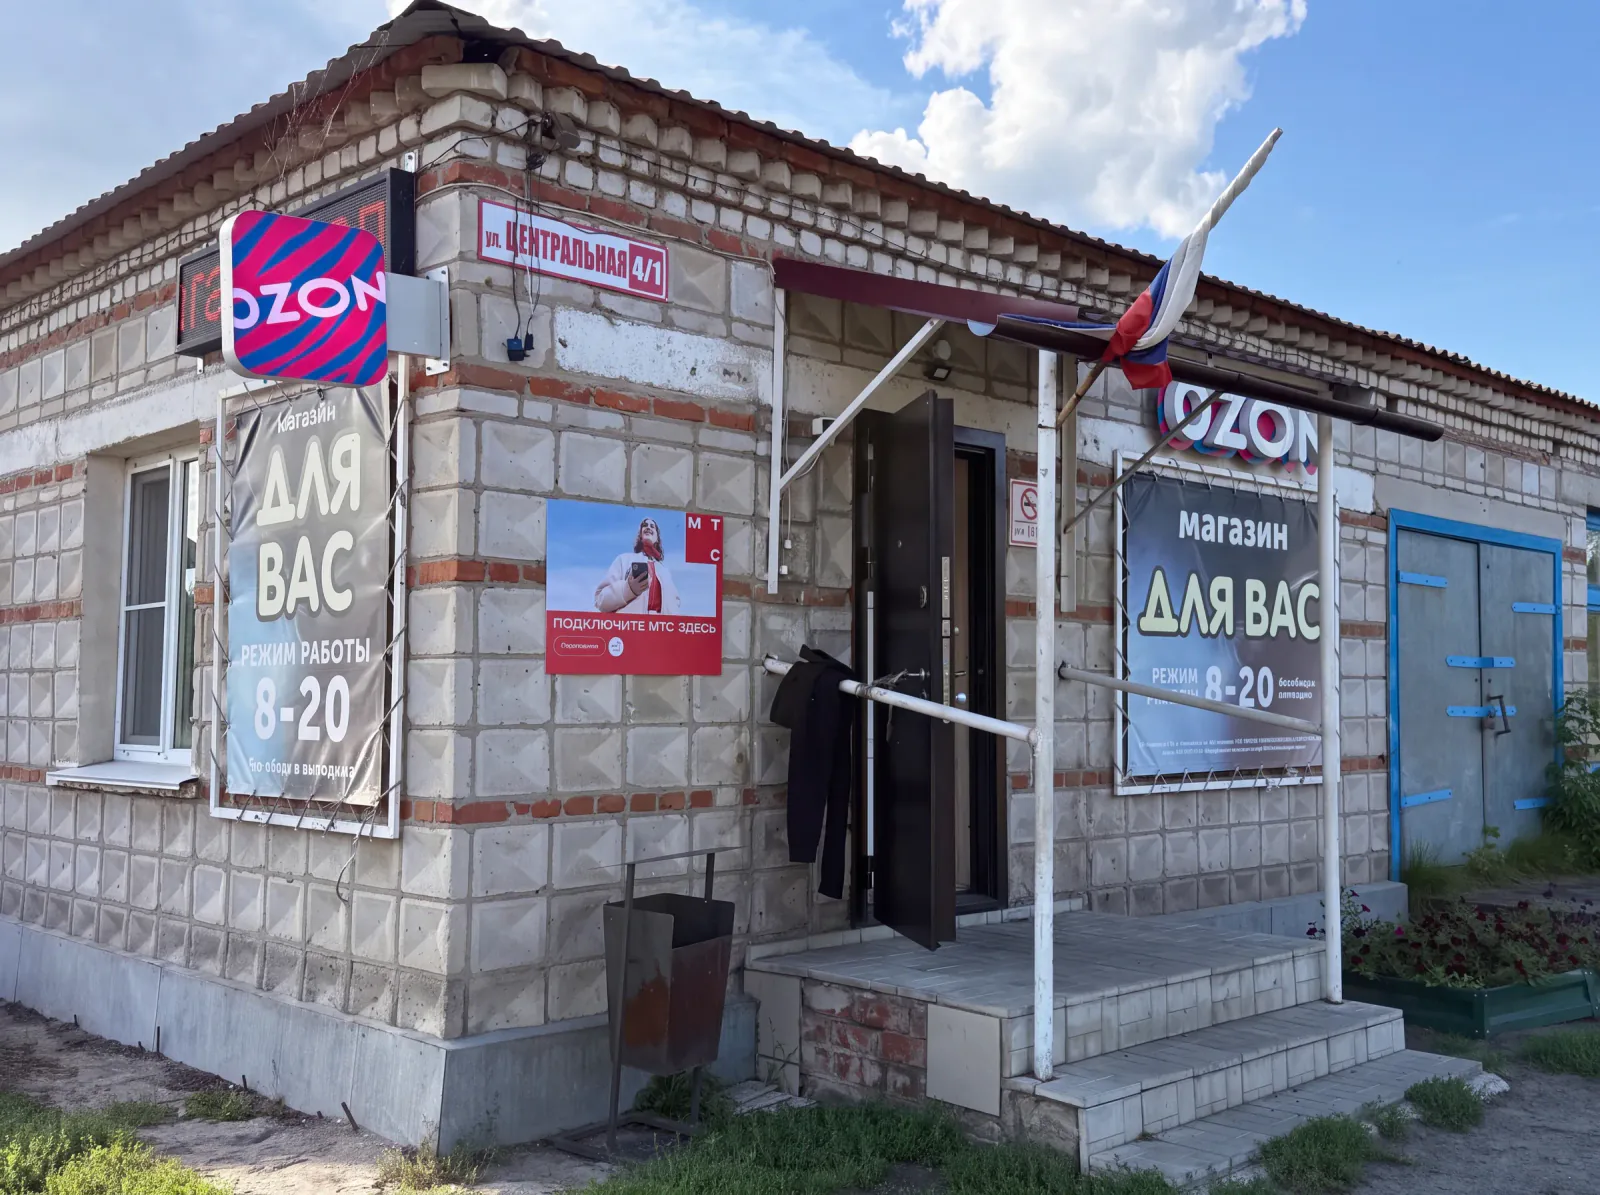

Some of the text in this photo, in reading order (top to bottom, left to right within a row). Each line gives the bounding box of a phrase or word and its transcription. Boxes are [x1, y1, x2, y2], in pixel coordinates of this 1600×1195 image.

[485, 220, 661, 286] ул. ЦЕНТРАЛЬНАЯ 4/1
[256, 432, 361, 527] ДЛЯ
[258, 530, 354, 616] ВАС
[1138, 569, 1320, 641] ДЛЯ ВАС
[241, 638, 370, 667] РЕЖИМ РАБОТЫ
[553, 617, 717, 634] ПОДКЛЮЧИТЕ МТС ЗДЕСЬ
[1152, 667, 1198, 684] РЕЖИМ
[1205, 665, 1274, 708] 8-20
[254, 675, 351, 743] 8-20
